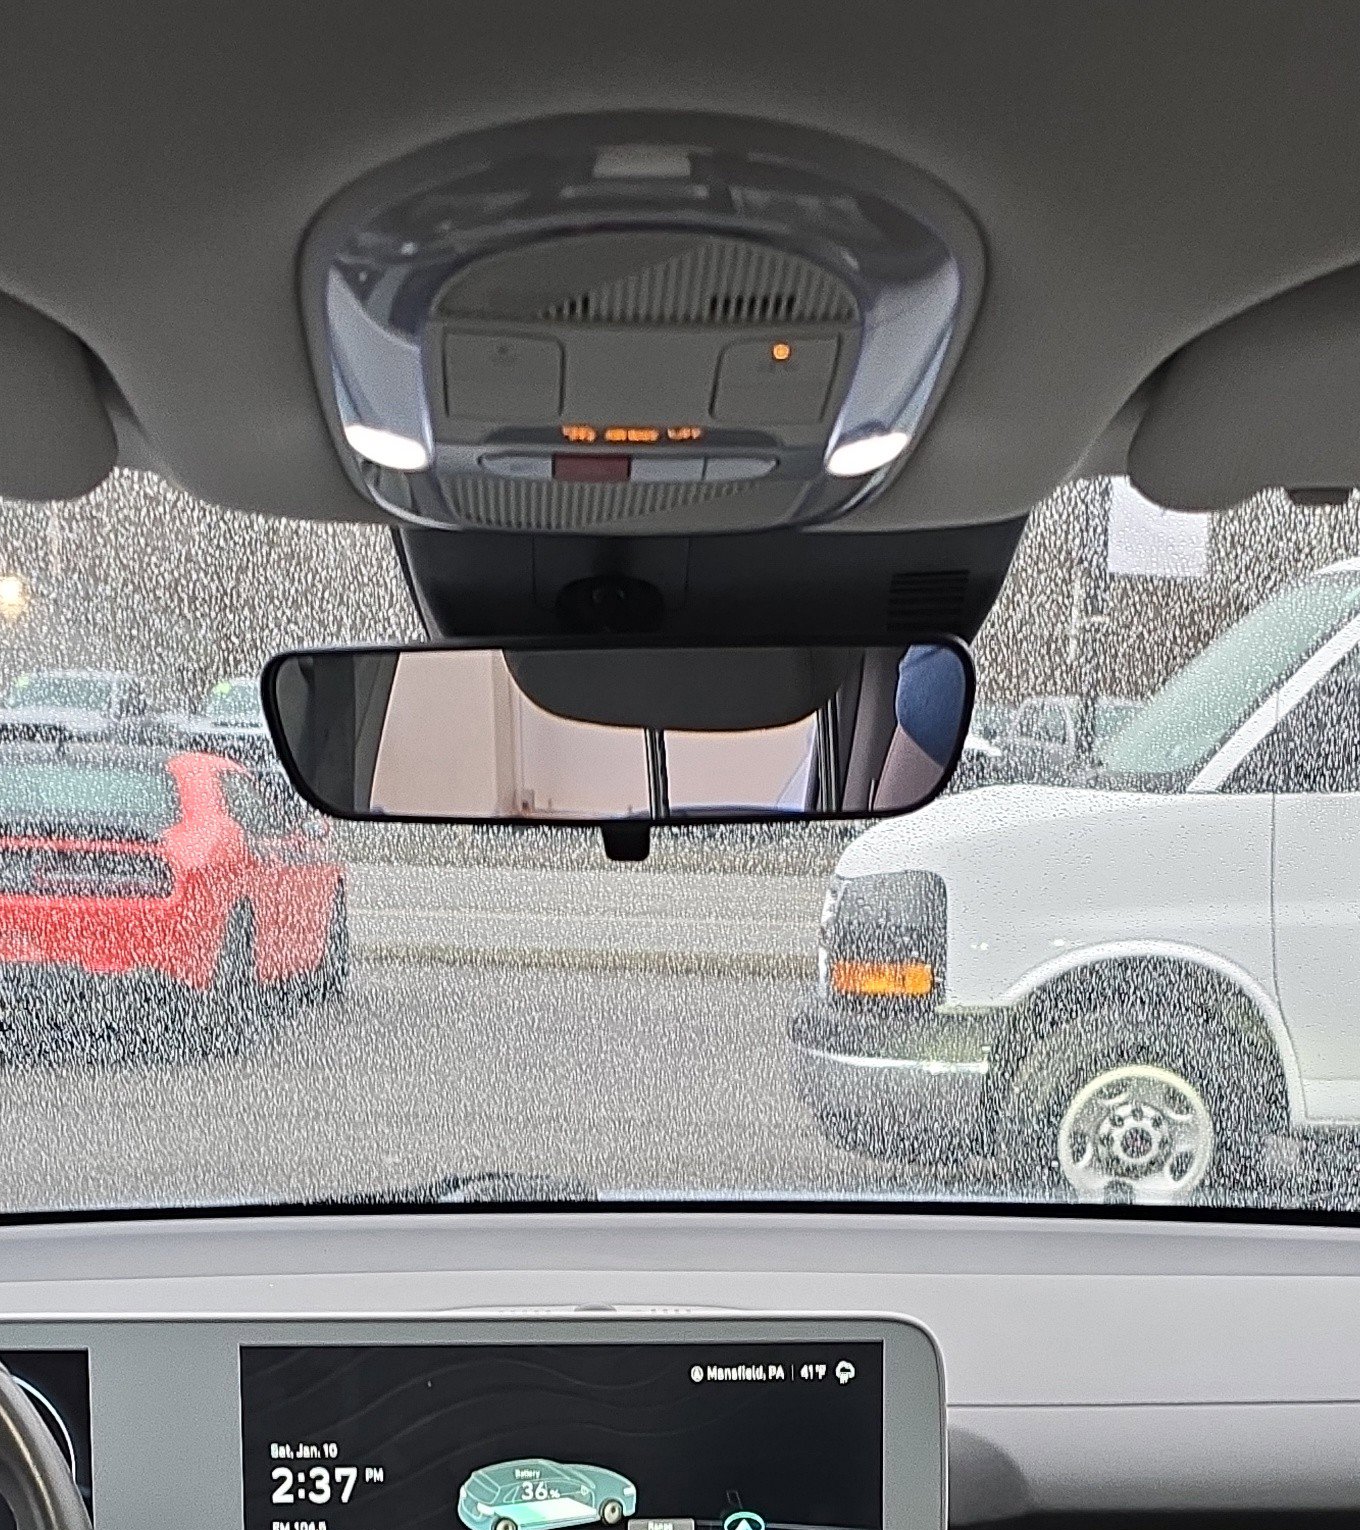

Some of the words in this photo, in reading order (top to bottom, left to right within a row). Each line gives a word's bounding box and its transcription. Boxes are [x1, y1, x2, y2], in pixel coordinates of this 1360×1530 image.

[768, 1364, 785, 1380] PA
[323, 1442, 338, 1459] 10
[271, 1466, 358, 1504] 2:37
[365, 1467, 384, 1482] PM
